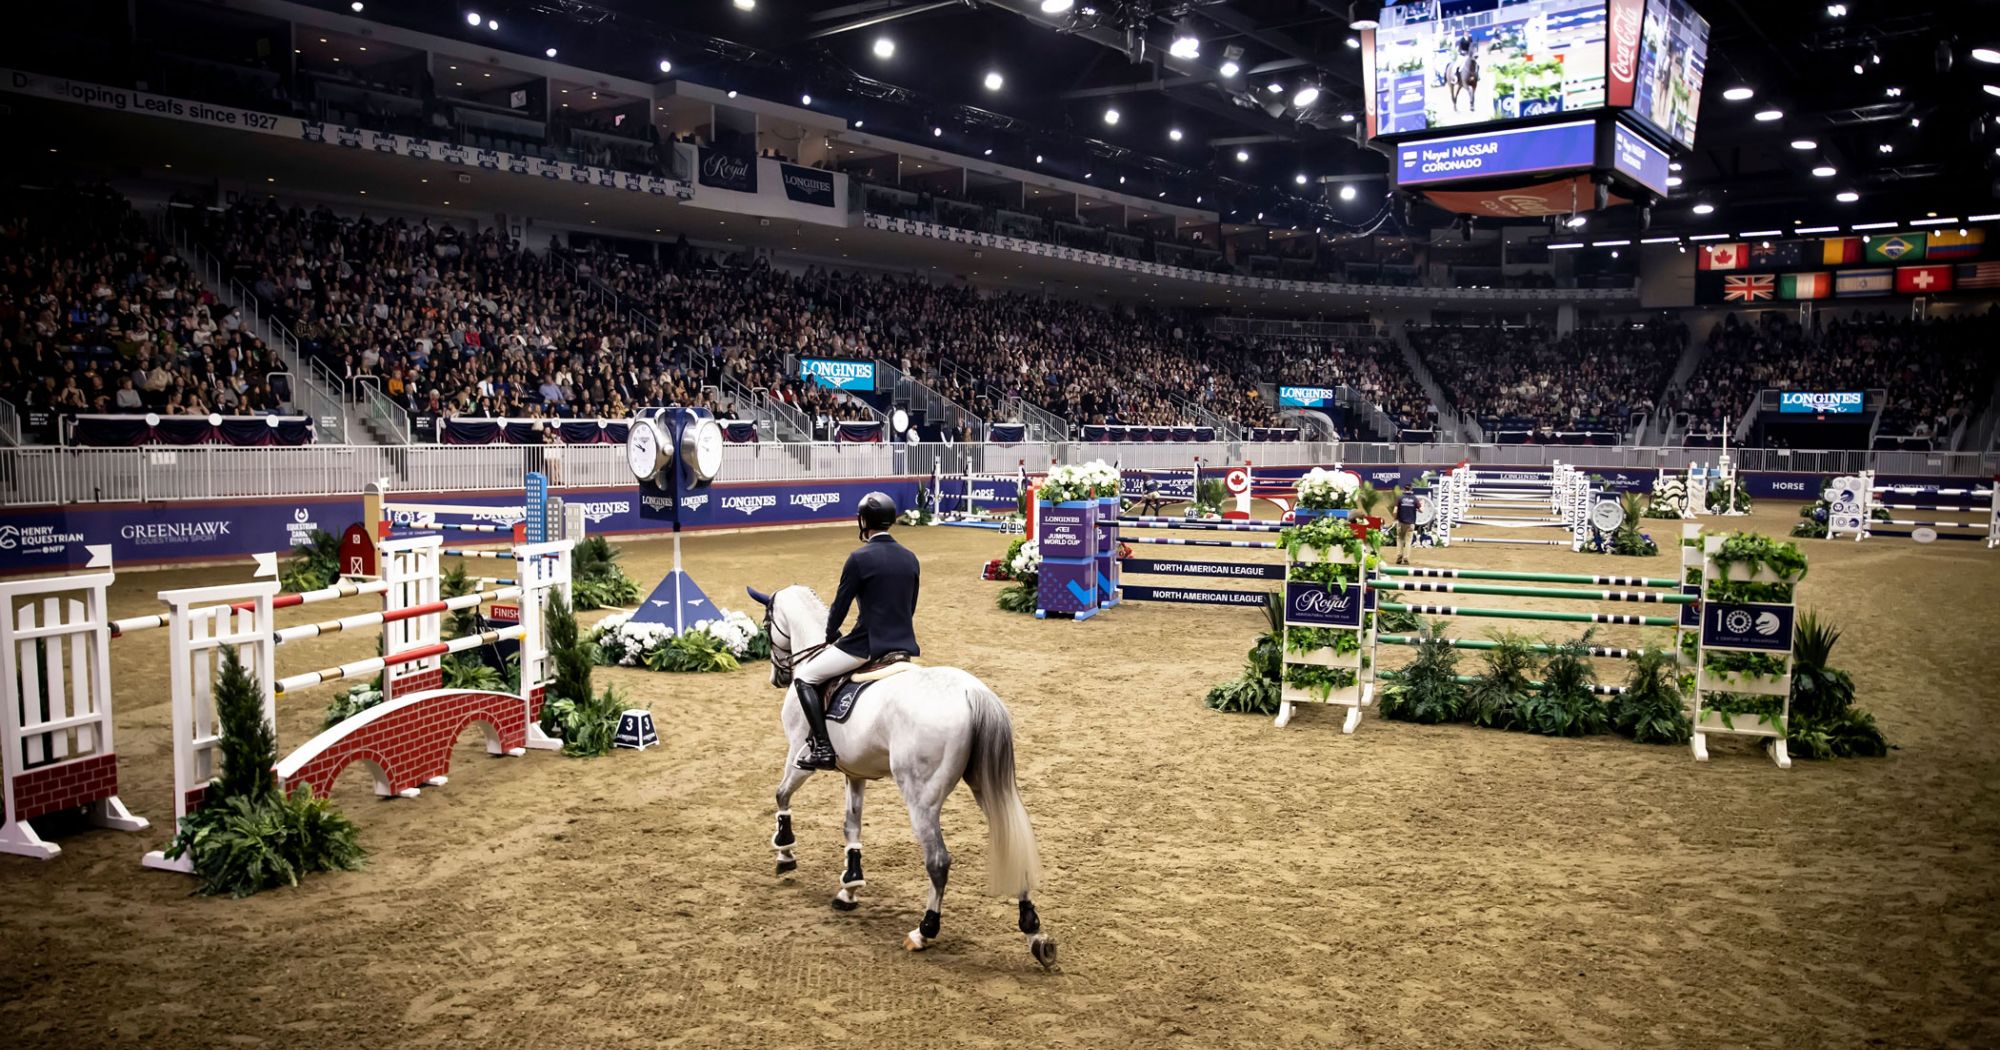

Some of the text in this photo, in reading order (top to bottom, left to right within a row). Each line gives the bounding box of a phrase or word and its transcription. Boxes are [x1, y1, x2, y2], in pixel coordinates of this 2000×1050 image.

[133, 94, 183, 115] Leafs
[190, 102, 235, 123] since
[243, 112, 278, 130] 1927
[1453, 142, 1498, 157] NASSAR
[704, 153, 749, 180] Royal
[1422, 158, 1481, 173] CORONADO
[785, 174, 831, 192] LONGINES
[802, 361, 872, 378] LONGINES
[1281, 387, 1333, 399] LONGINES
[1783, 393, 1861, 404] LONGINES
[1772, 482, 1805, 490] HORSE
[642, 494, 673, 507] LONGINES
[681, 494, 708, 507] LONGINES
[721, 495, 776, 508] LONGINES
[790, 493, 840, 505] LONGINES
[582, 501, 630, 514] NGINES
[1440, 480, 1450, 537] LONGINES
[1576, 483, 1587, 542] LONGINES
[21, 526, 54, 537] HENRY
[121, 521, 230, 539] GREENHAWK
[21, 533, 84, 546] EQUESTRIAN
[135, 534, 217, 545] EQUESTRIAN SPORT
[49, 545, 65, 553] NFP
[1153, 563, 1264, 575] NORTH AMERICAN LEAGUE
[1153, 590, 1263, 603] NORTH AMERICAN LEAGUE
[1295, 589, 1350, 613] Royal
[494, 607, 519, 618] FINISH
[626, 717, 633, 731] 3
[644, 717, 650, 730] 3
